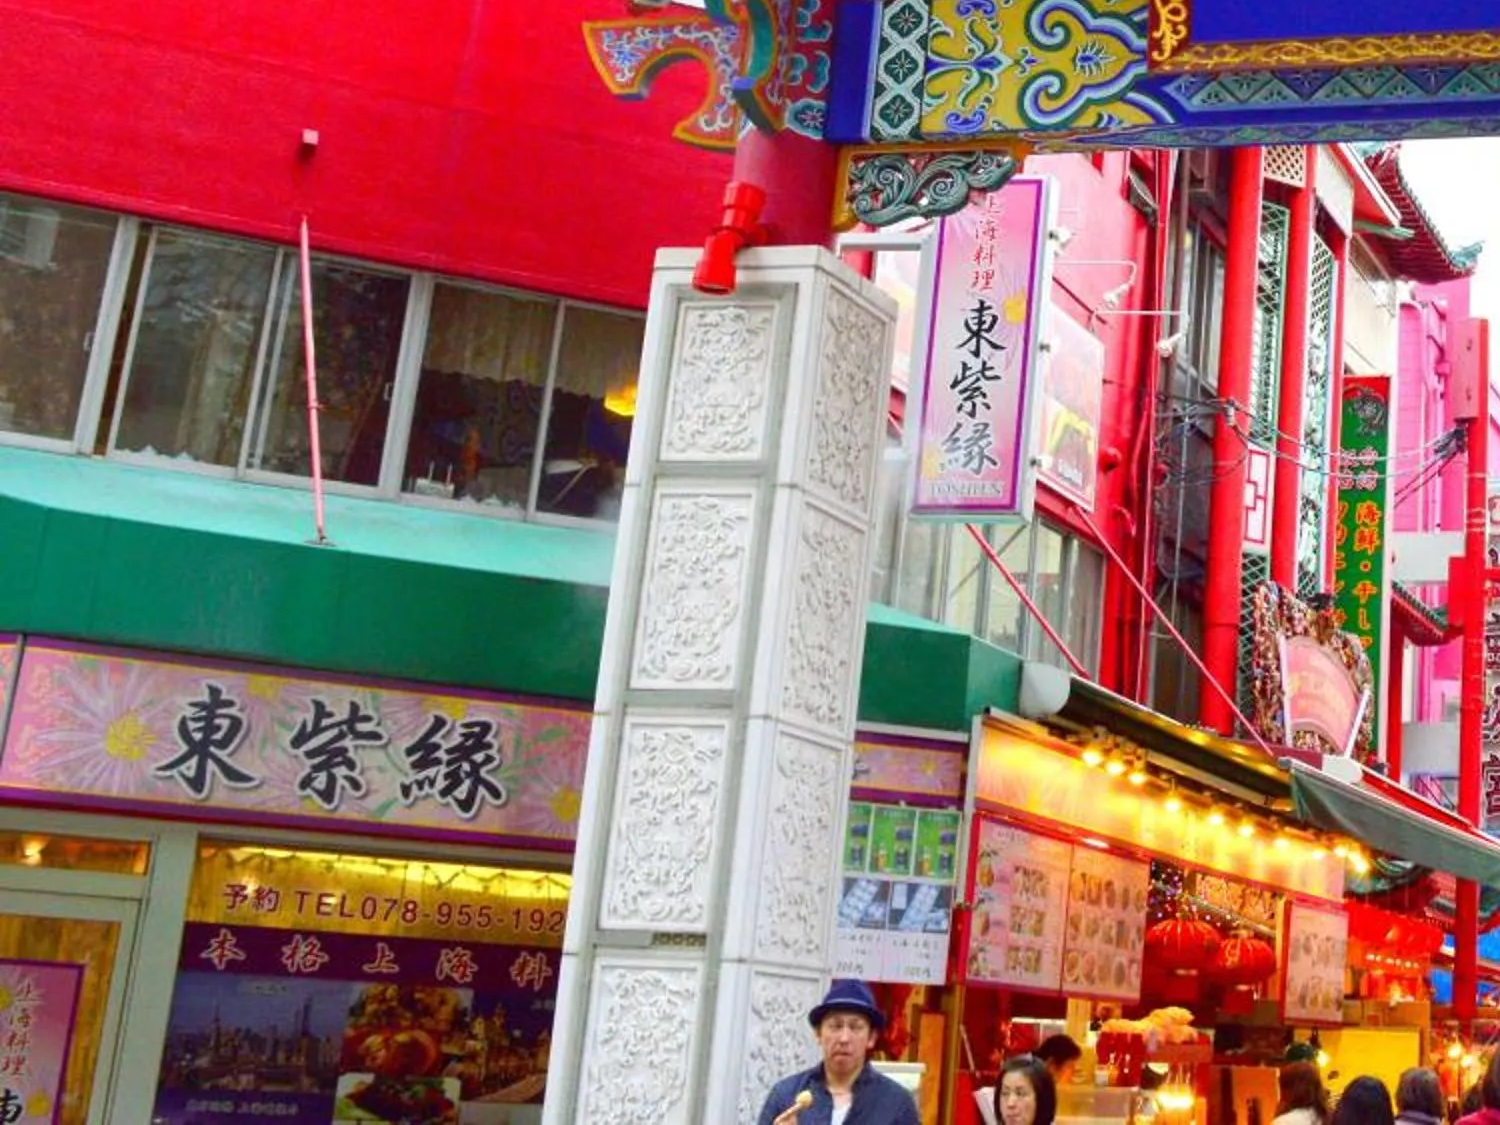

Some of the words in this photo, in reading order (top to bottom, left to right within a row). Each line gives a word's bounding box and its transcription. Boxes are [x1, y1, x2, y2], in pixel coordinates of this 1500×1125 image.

[222, 883, 281, 913] 予約
[199, 927, 554, 993] 本格上海料
